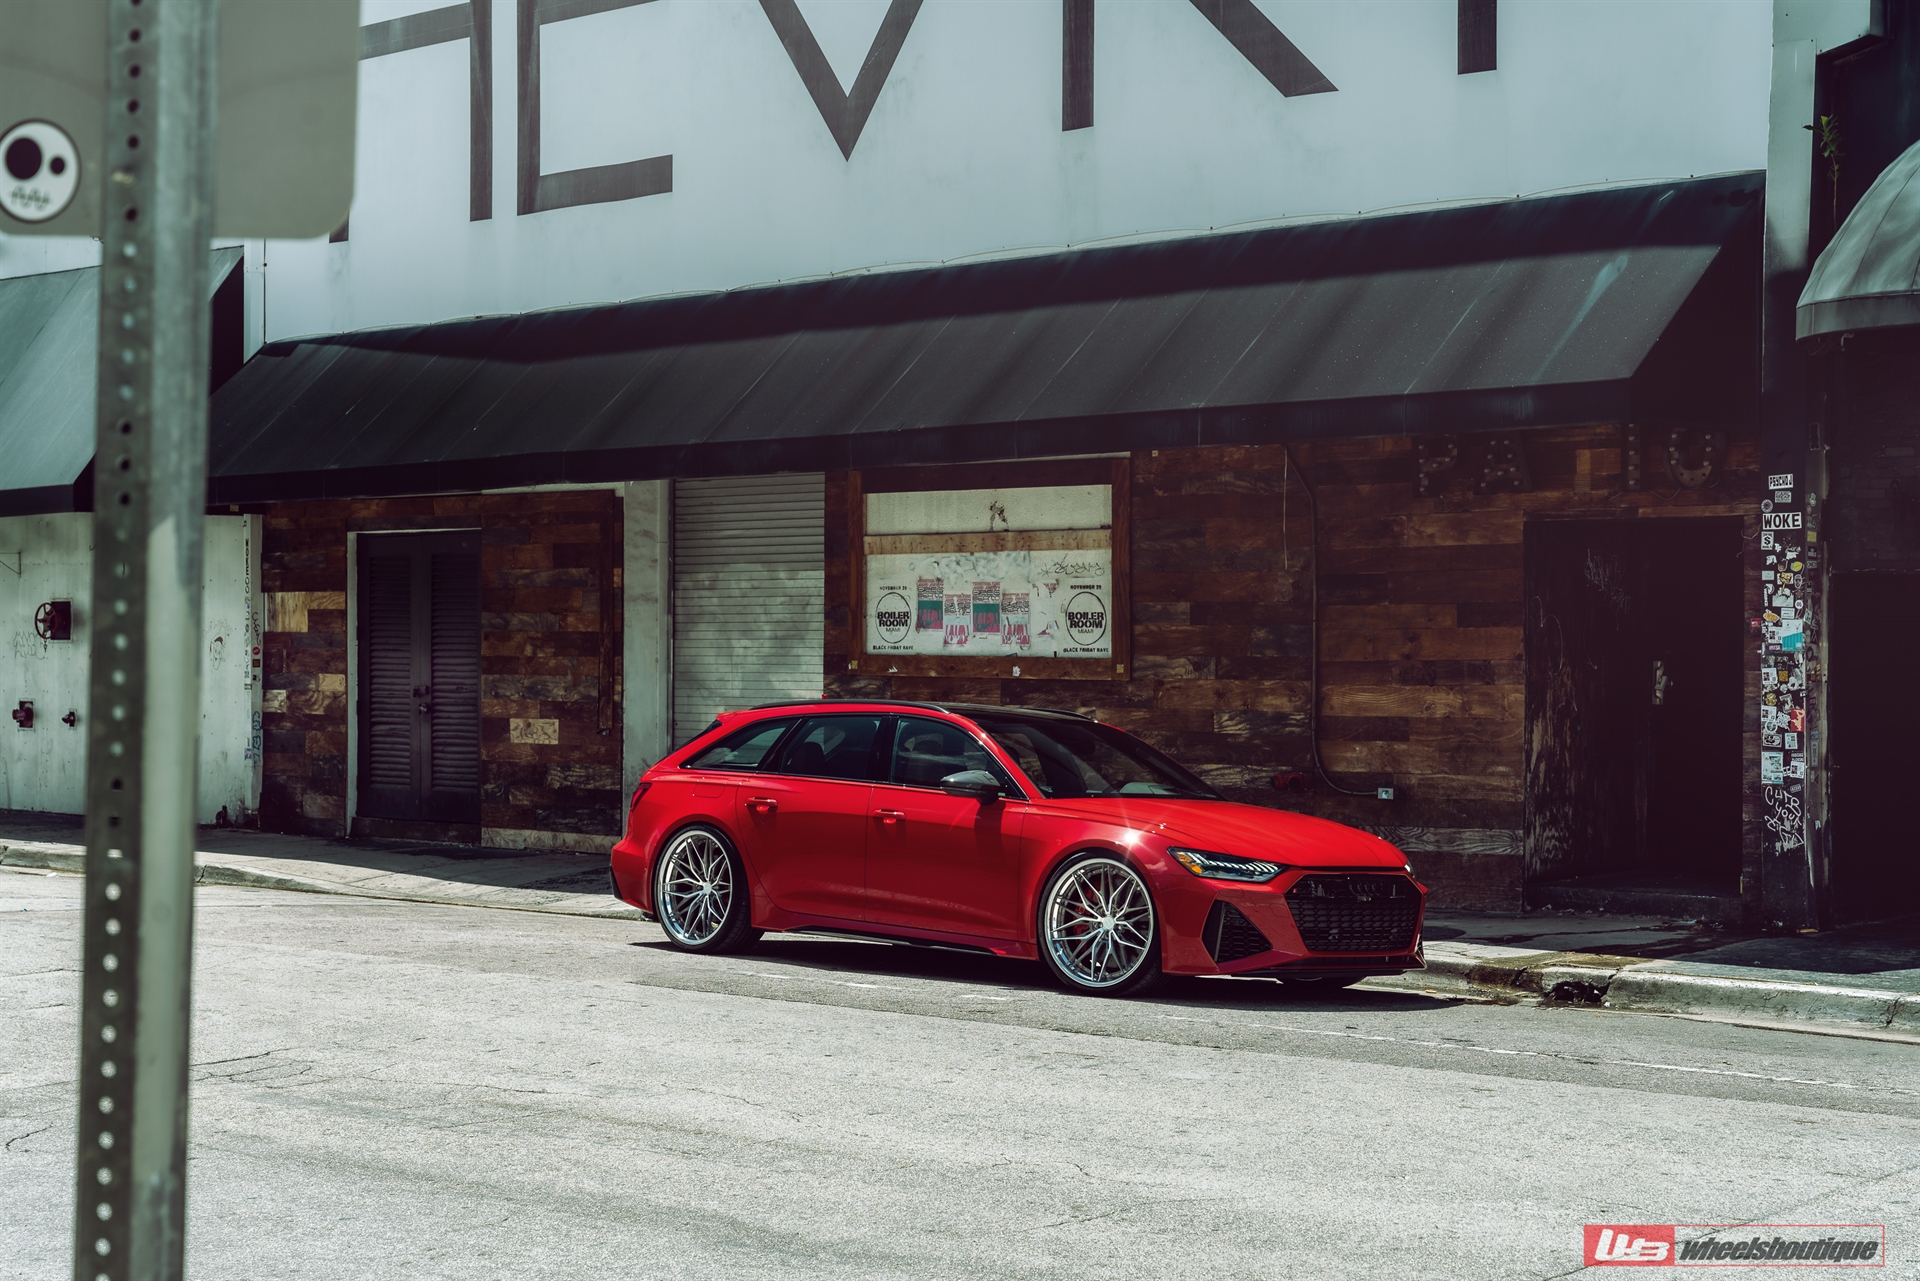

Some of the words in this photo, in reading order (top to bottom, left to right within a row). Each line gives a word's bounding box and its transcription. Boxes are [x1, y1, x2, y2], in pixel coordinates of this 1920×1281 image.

[1763, 513, 1801, 529] WOKE
[877, 611, 910, 620] BOILER
[1068, 611, 1105, 620] BOILER
[879, 619, 908, 627] ROOM
[1070, 620, 1103, 629] ROOM
